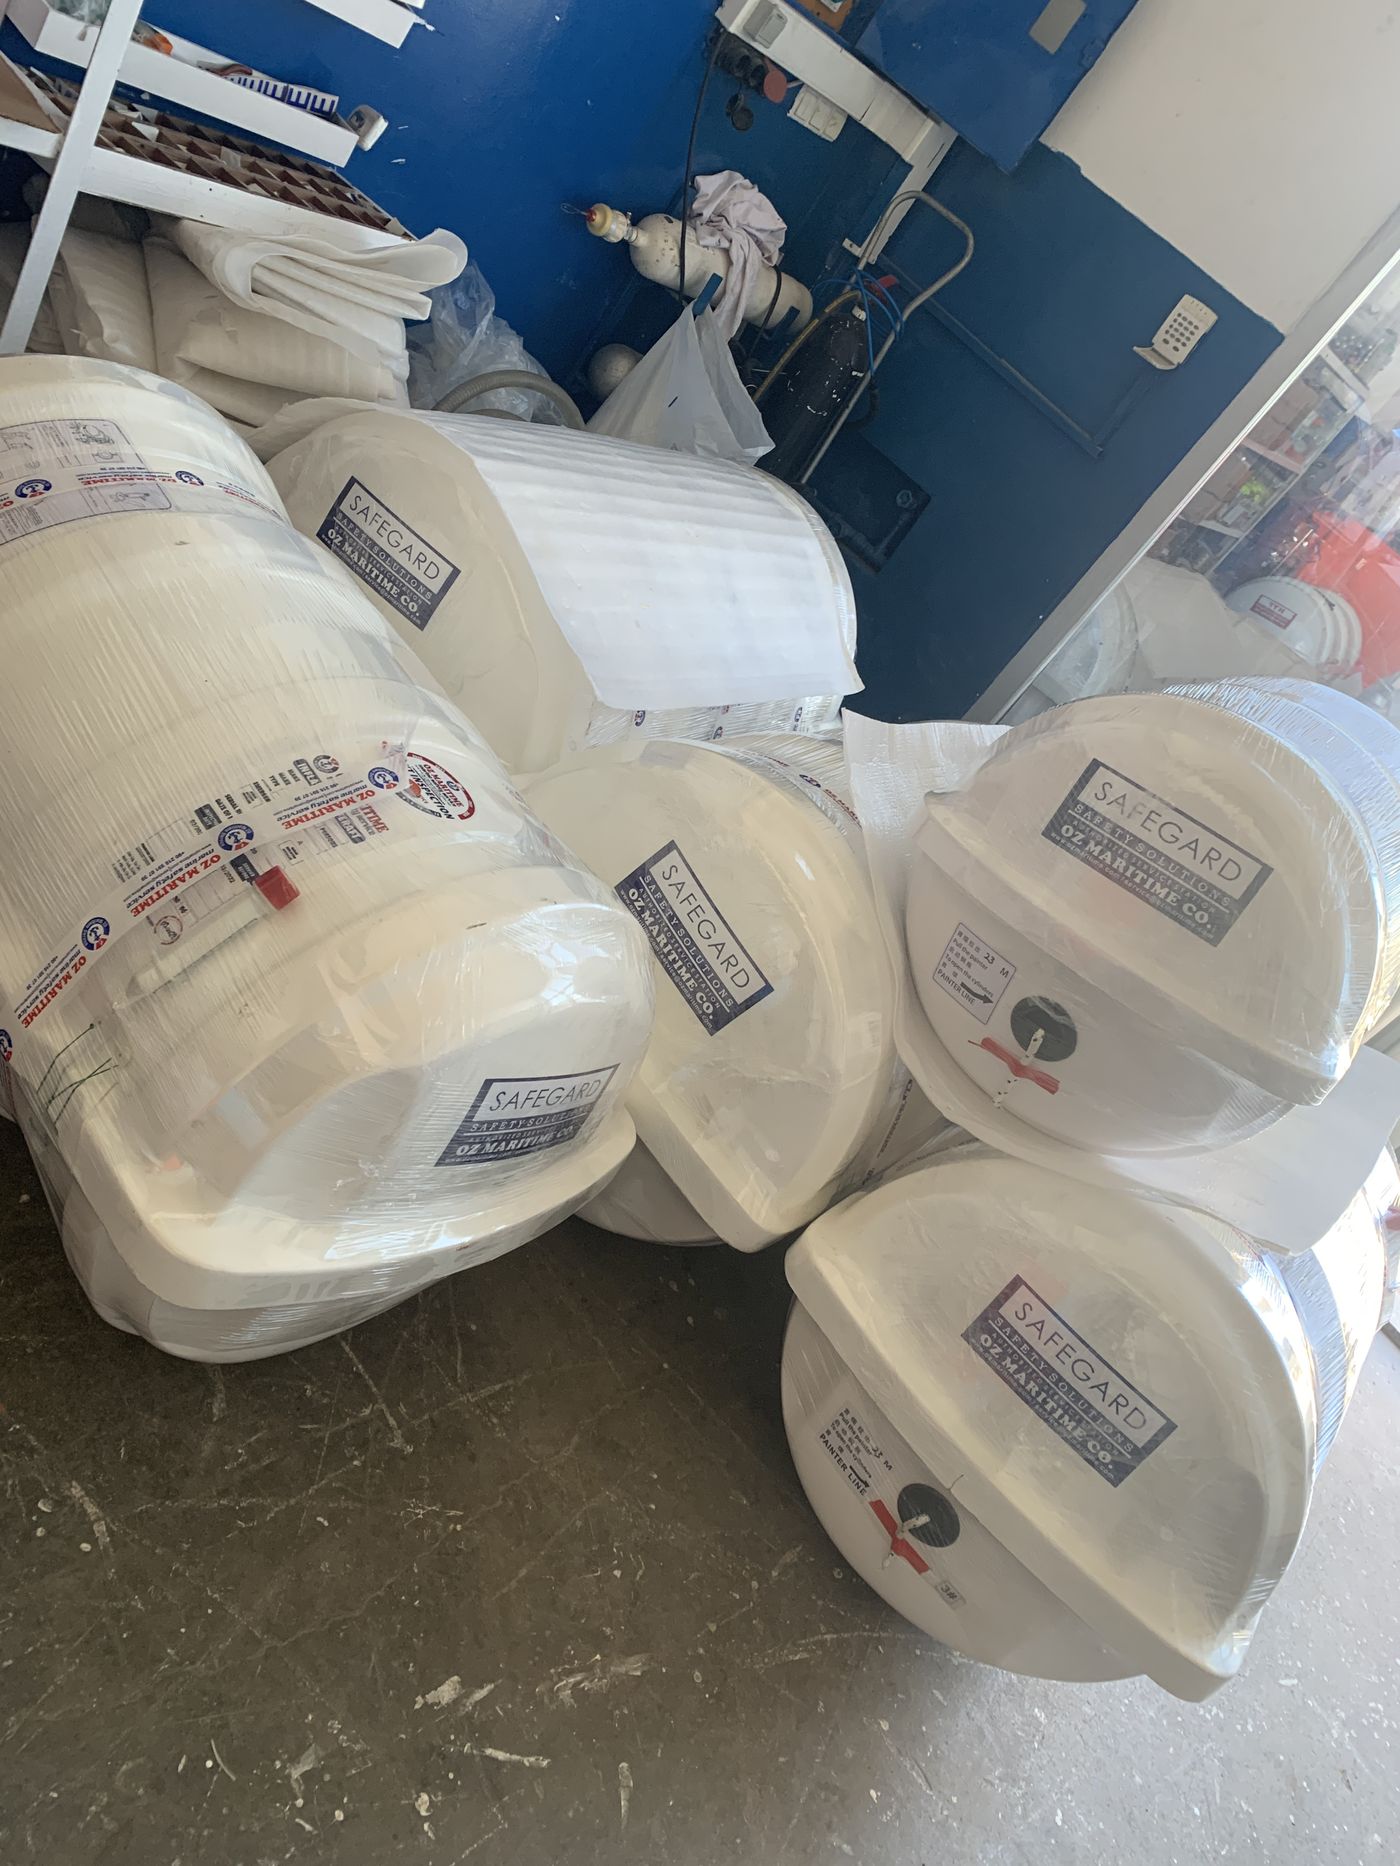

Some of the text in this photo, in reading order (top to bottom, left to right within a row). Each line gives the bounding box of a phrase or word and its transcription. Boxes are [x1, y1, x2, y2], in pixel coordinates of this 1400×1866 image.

[335, 511, 432, 600] SAFETY SOLUTIONS
[350, 493, 441, 582] SAFEGARD
[326, 527, 422, 616] OZ MARITIME CO.
[309, 794, 339, 810] safety
[338, 783, 367, 798] marine
[355, 788, 376, 802] OZ
[410, 772, 454, 822] INSPECTION
[275, 805, 310, 823] service
[280, 795, 356, 830] MARITIME
[1093, 781, 1244, 883] SAFEGARD
[154, 866, 184, 888] safety
[183, 847, 214, 869] marine
[199, 852, 221, 870] OZ
[1059, 823, 1216, 928] OZ MARITIME CO.
[1073, 804, 1231, 907] SAFETY SOLUTIONS
[125, 884, 155, 908] service
[129, 866, 199, 917] MARITIME
[1129, 856, 1173, 887] SERVICE
[1172, 883, 1216, 914] STATION
[637, 887, 720, 1010] AUTHORIZED SERVICE STATION
[642, 874, 734, 1009] SAFETY SOLUTIONS
[660, 863, 752, 991] SAFEGARD
[69, 954, 88, 973] OZ
[626, 887, 717, 1020] OZ MARITIME CO.
[952, 937, 962, 948] Pull
[961, 946, 970, 955] the
[969, 954, 987, 969] painter
[983, 952, 995, 964] 23
[999, 967, 1008, 978] M
[16, 948, 81, 1019] marine safety service
[19, 971, 73, 1028] MARITIME
[937, 968, 961, 992] PAINTER
[961, 990, 974, 1004] LINE
[950, 959, 962, 971] open
[963, 970, 971, 979] the
[971, 978, 993, 997] cylinders
[486, 1078, 603, 1112] SAFEGARD
[454, 1144, 481, 1155] OZ
[479, 1130, 558, 1154] MARITIME
[468, 1118, 525, 1132] SAFETY
[992, 1316, 1135, 1454] SAFETY SOLUTIONS
[1012, 1302, 1149, 1433] SAFEGARD
[977, 1332, 1118, 1470] OZ MARITIME CO.
[839, 1412, 872, 1455] Pull the painter
[819, 1433, 847, 1471] PAINTER
[847, 1472, 866, 1496] LINE
[845, 1443, 853, 1453] the
[851, 1452, 872, 1478] cylinders
[883, 1459, 892, 1470] M
